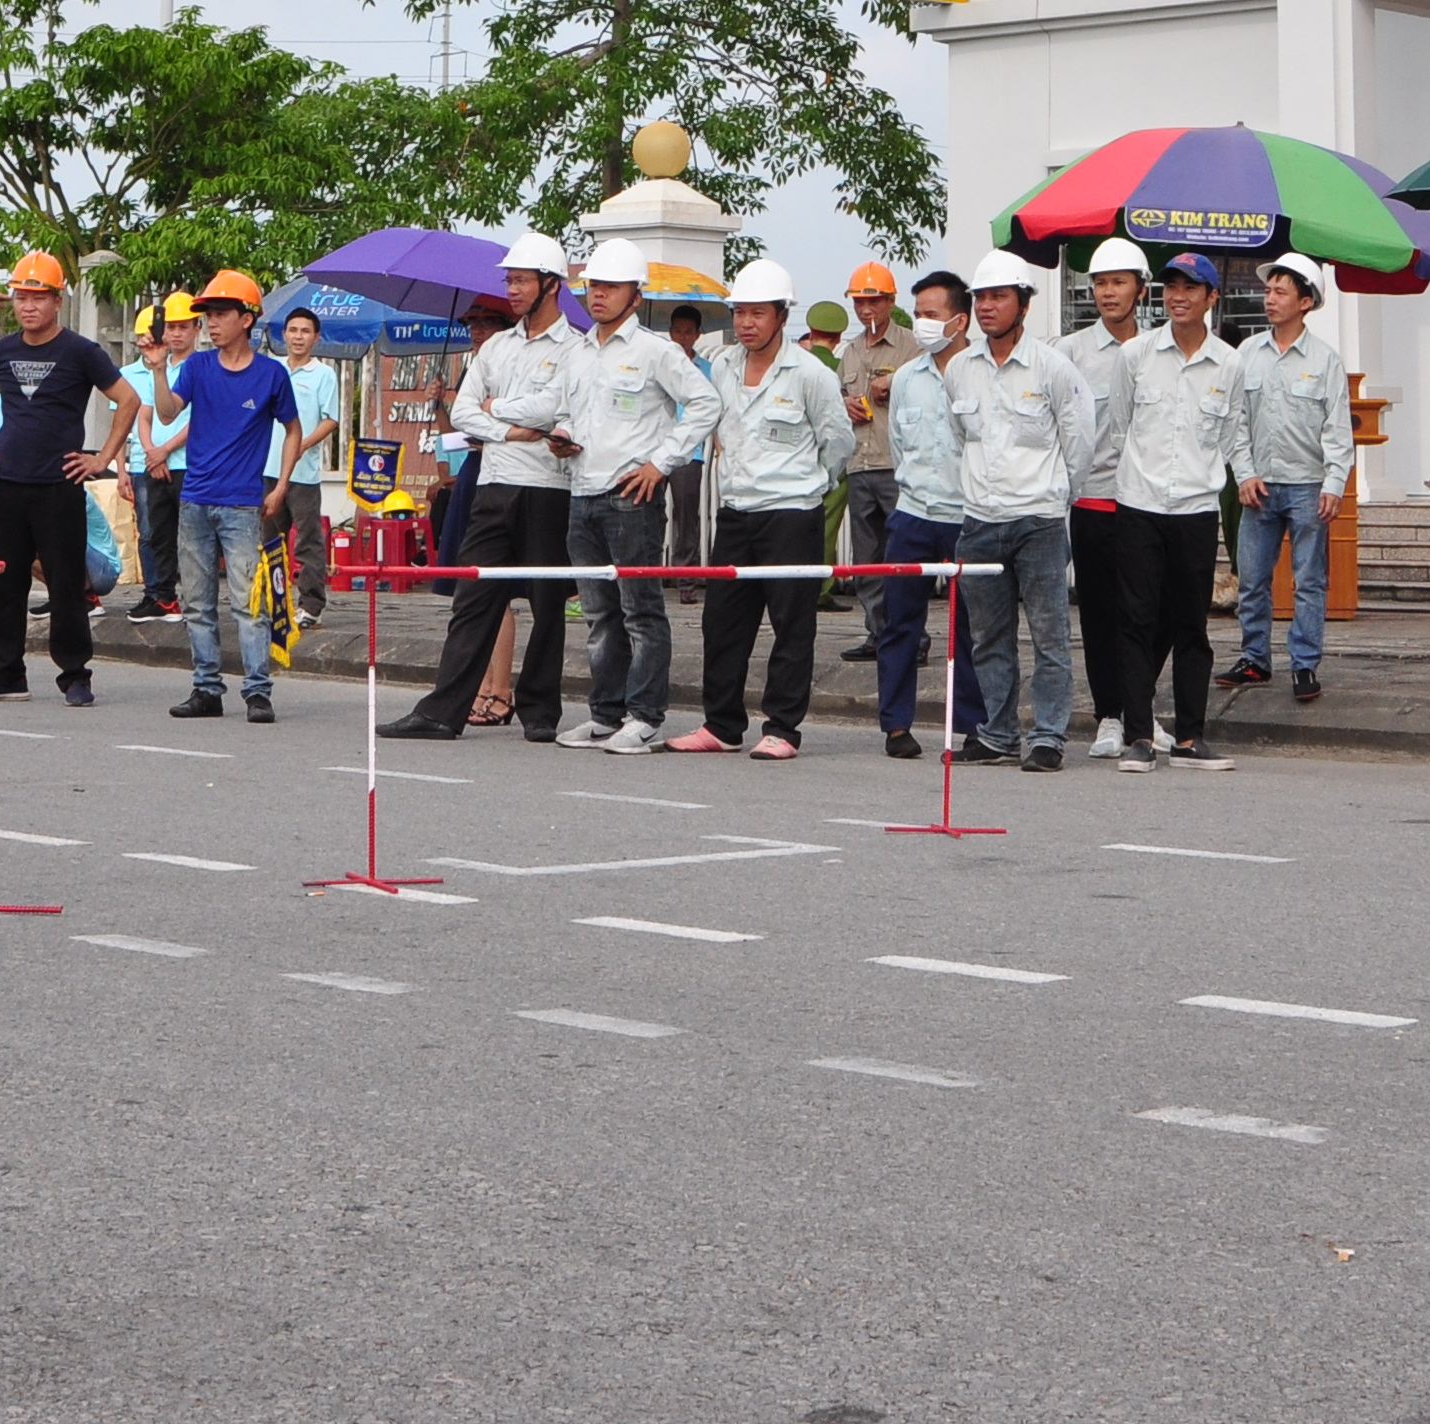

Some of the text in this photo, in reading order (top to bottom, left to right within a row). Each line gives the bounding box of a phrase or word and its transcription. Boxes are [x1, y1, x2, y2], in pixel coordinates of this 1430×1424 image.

[1169, 210, 1268, 229] KIM TRANG
[309, 292, 365, 307] true
[422, 324, 449, 338] true
